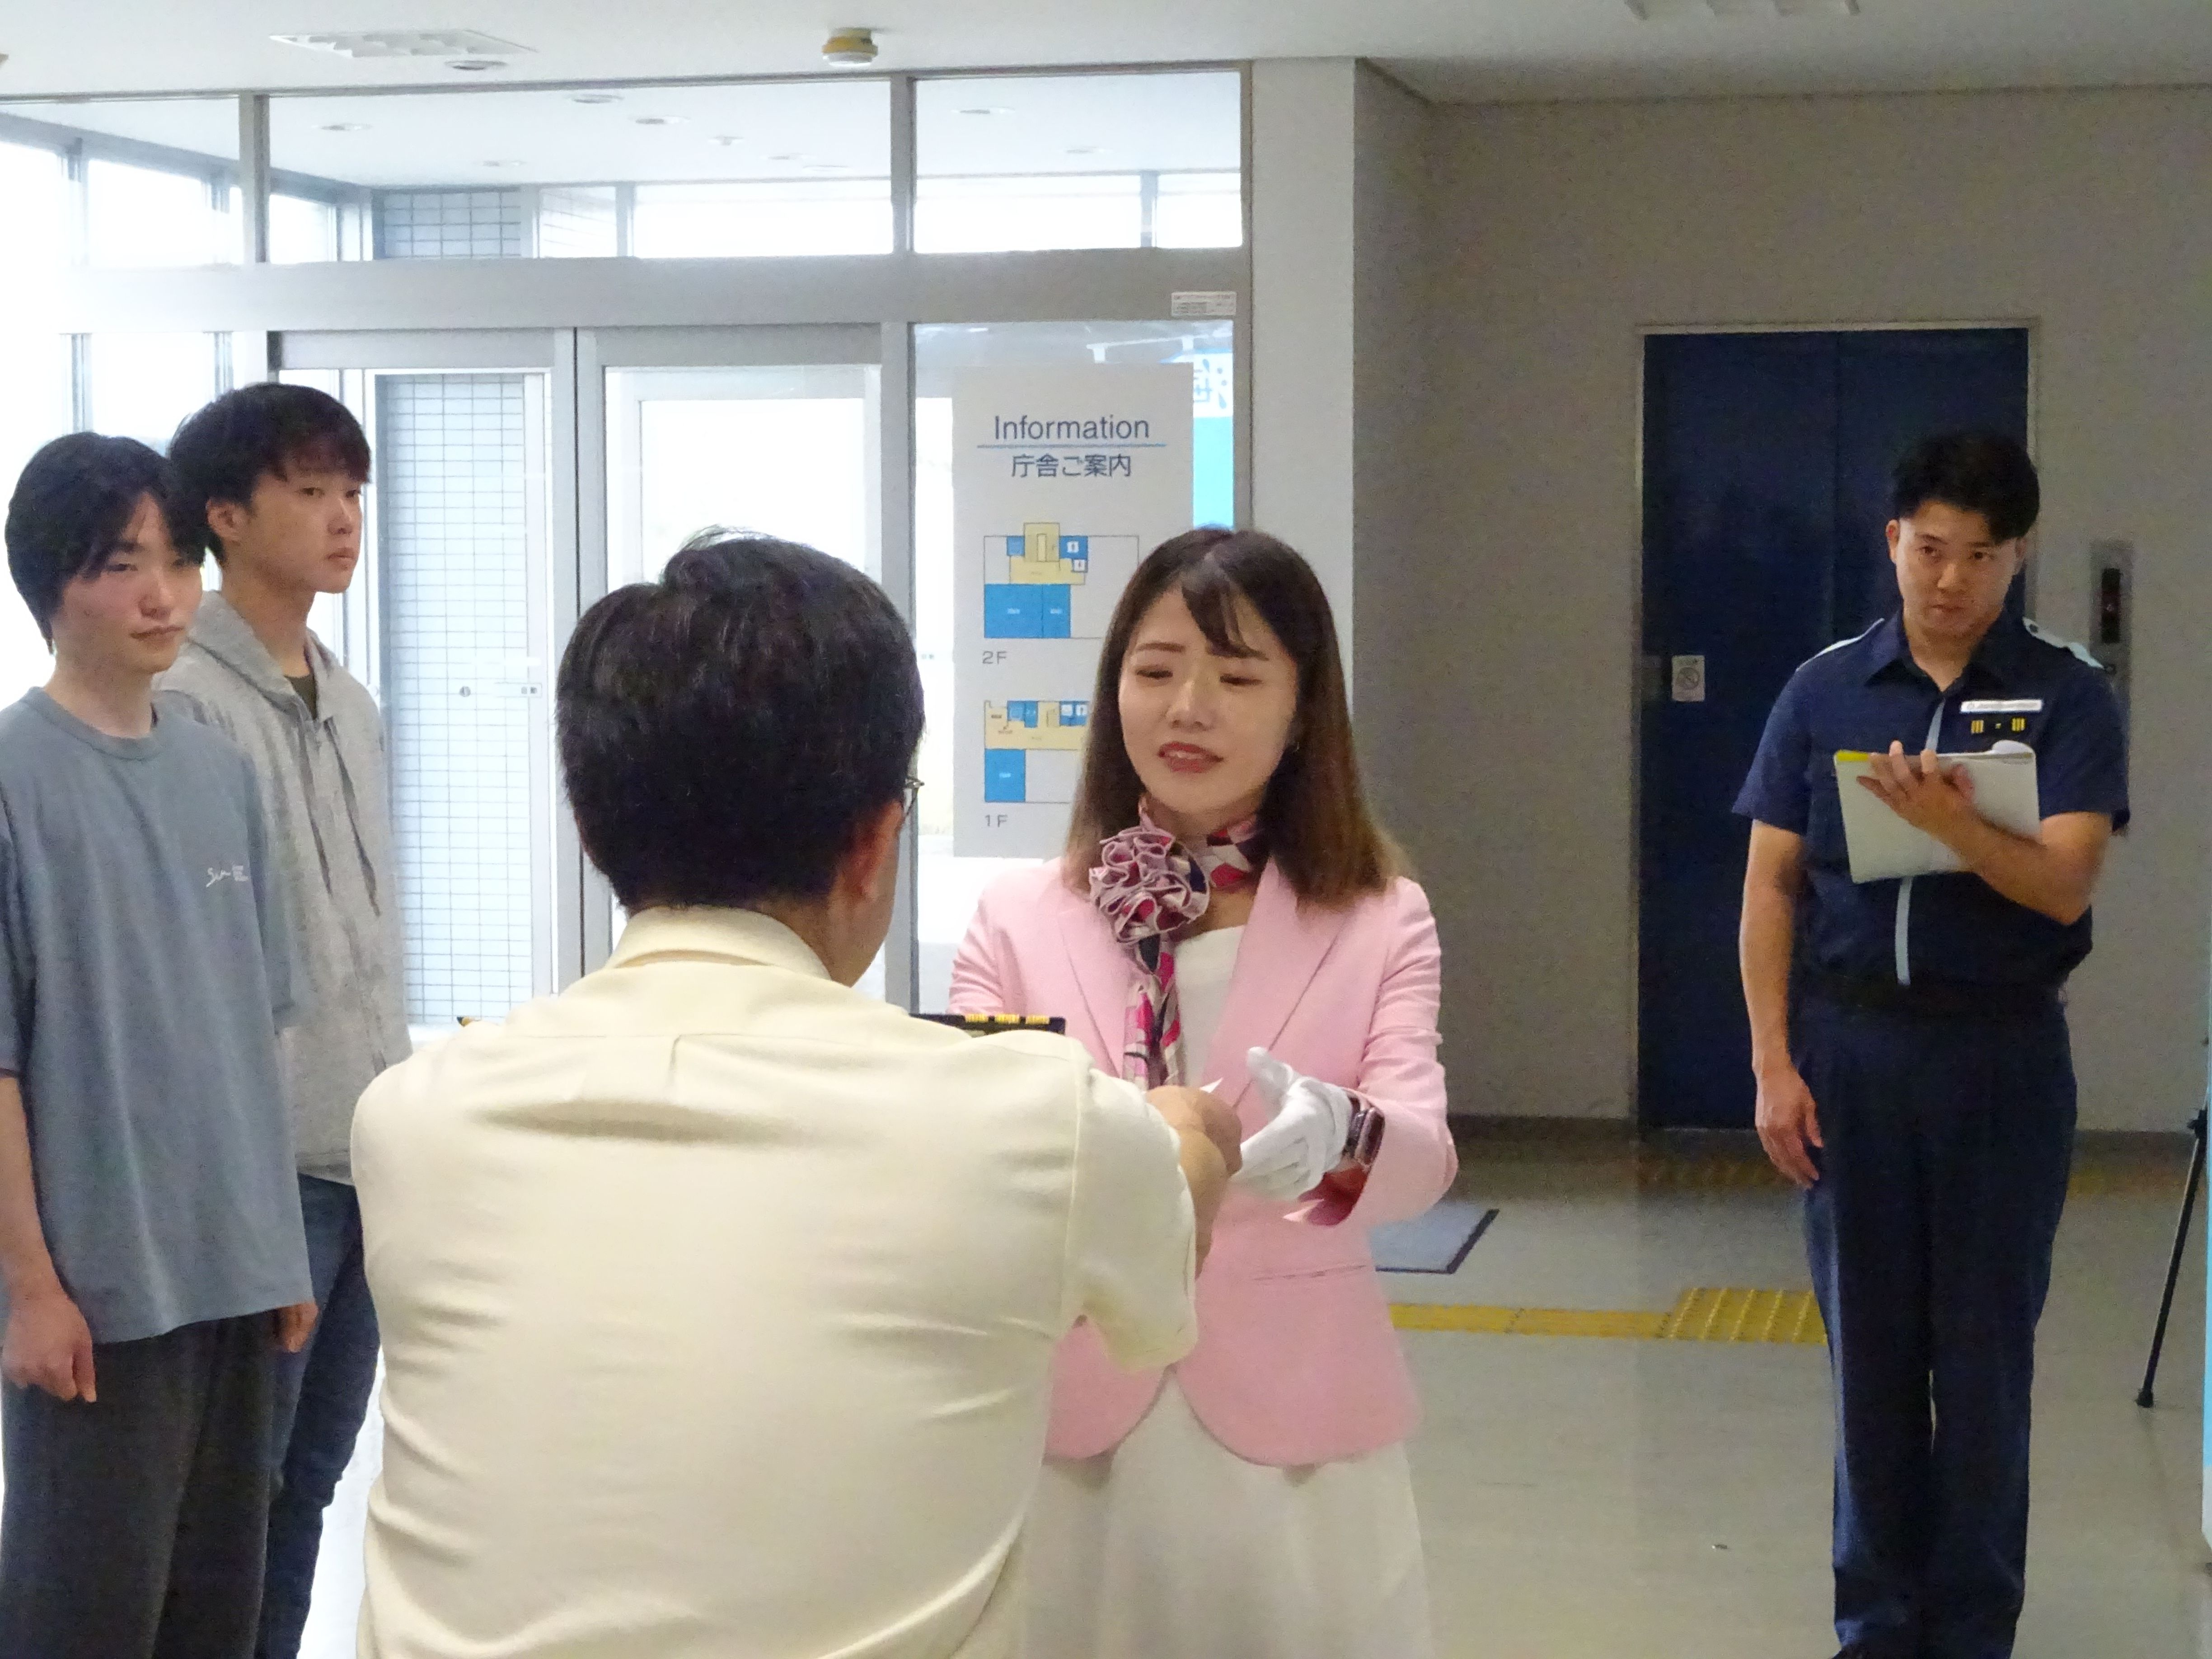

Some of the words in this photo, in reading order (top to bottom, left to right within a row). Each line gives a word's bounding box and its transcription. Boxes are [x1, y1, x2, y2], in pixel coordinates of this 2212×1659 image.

[995, 415, 1149, 440] Information
[1012, 453, 1131, 478] 庁舎ご案内
[982, 651, 1007, 665] 2F
[985, 814, 1008, 828] 1F
